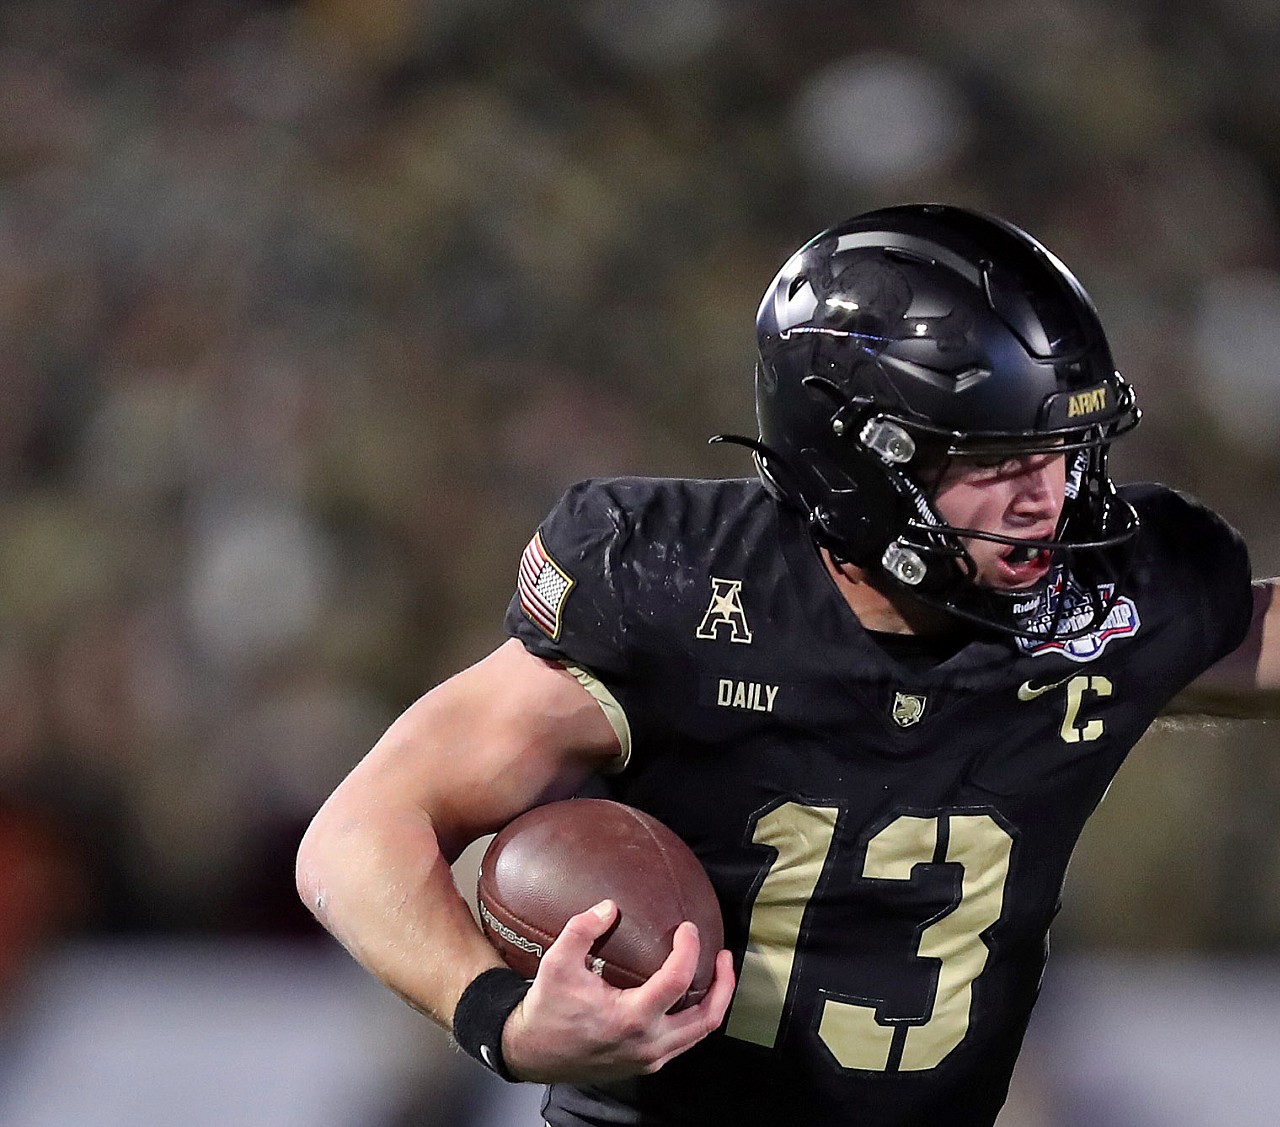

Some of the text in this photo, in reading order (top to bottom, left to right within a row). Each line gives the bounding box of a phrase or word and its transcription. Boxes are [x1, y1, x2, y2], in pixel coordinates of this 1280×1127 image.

[1068, 387, 1107, 419] ARMY
[696, 577, 752, 644] A
[716, 678, 780, 713] DAILY
[1060, 675, 1113, 744] C
[724, 800, 1014, 1073] 13
